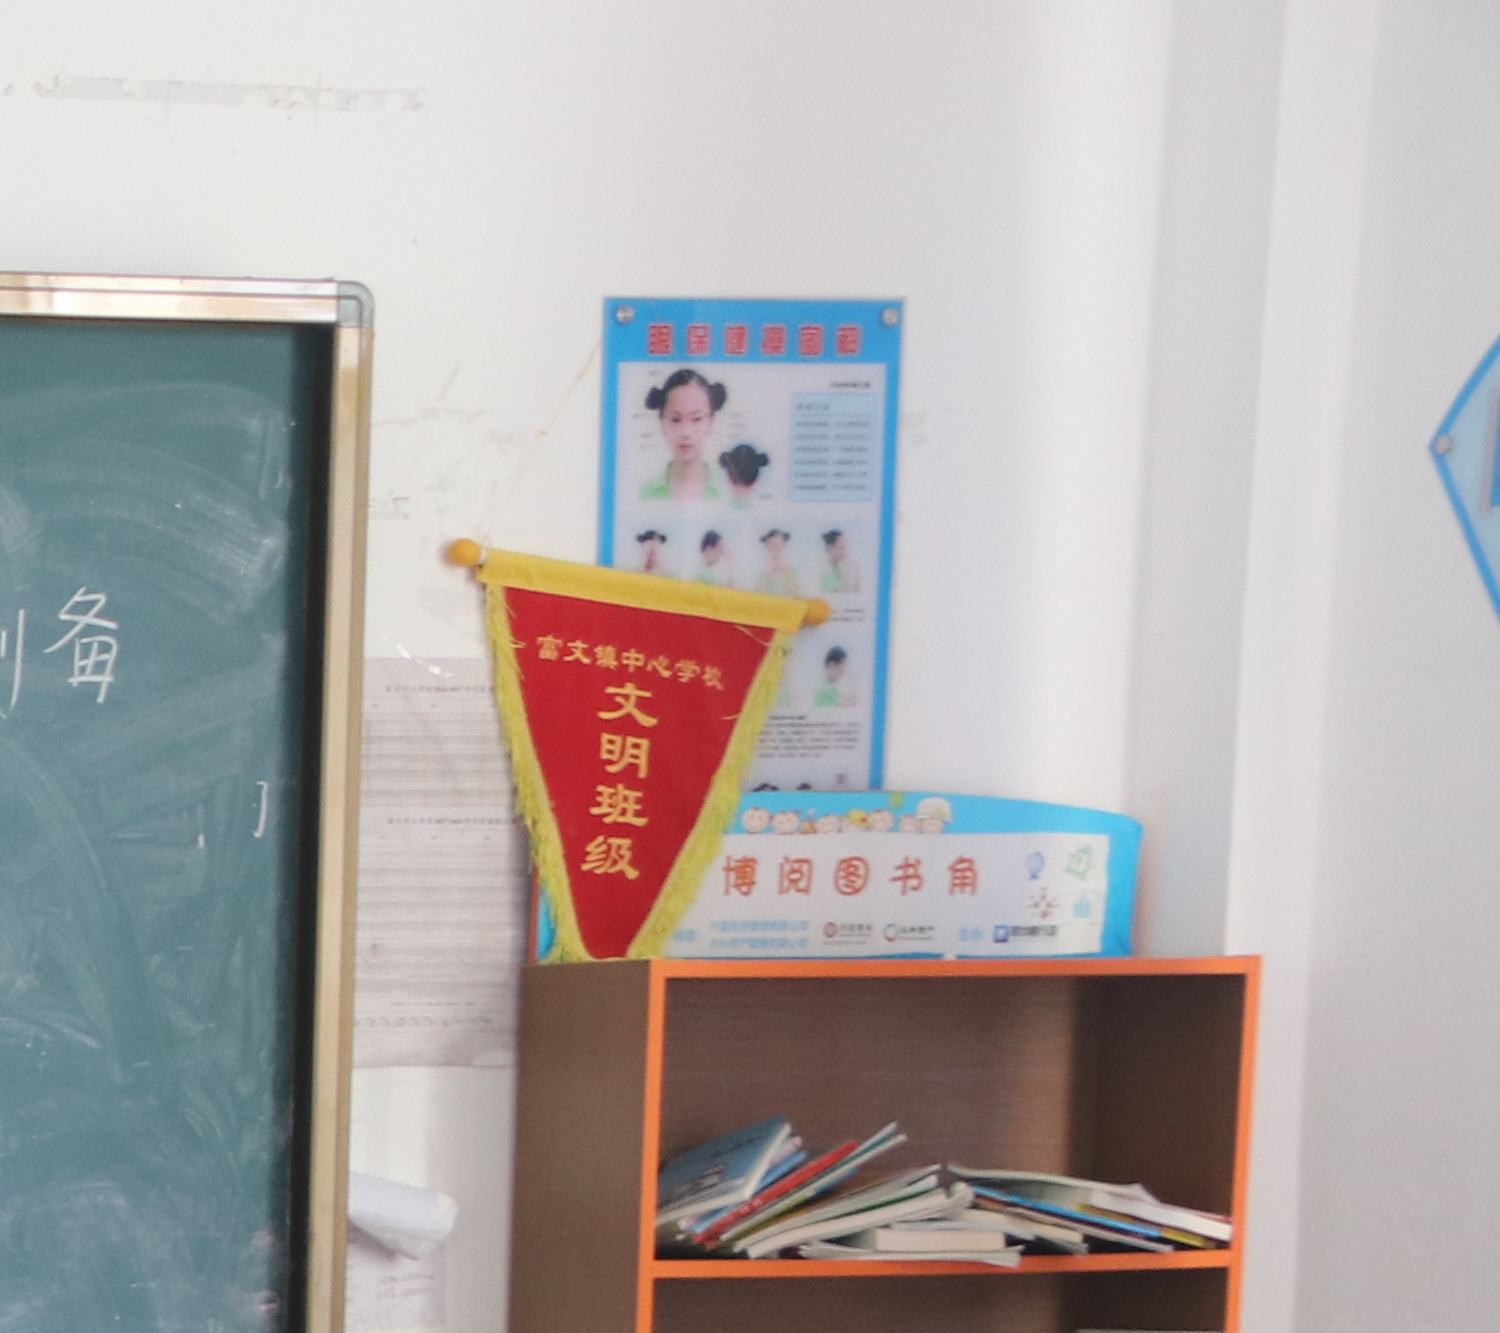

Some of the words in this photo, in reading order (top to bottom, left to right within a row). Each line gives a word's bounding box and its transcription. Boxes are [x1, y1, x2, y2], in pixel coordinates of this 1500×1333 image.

[536, 634, 724, 691] 富文镇中心学校
[580, 681, 660, 881] 文明班级
[721, 855, 980, 897] 博阅图书角
